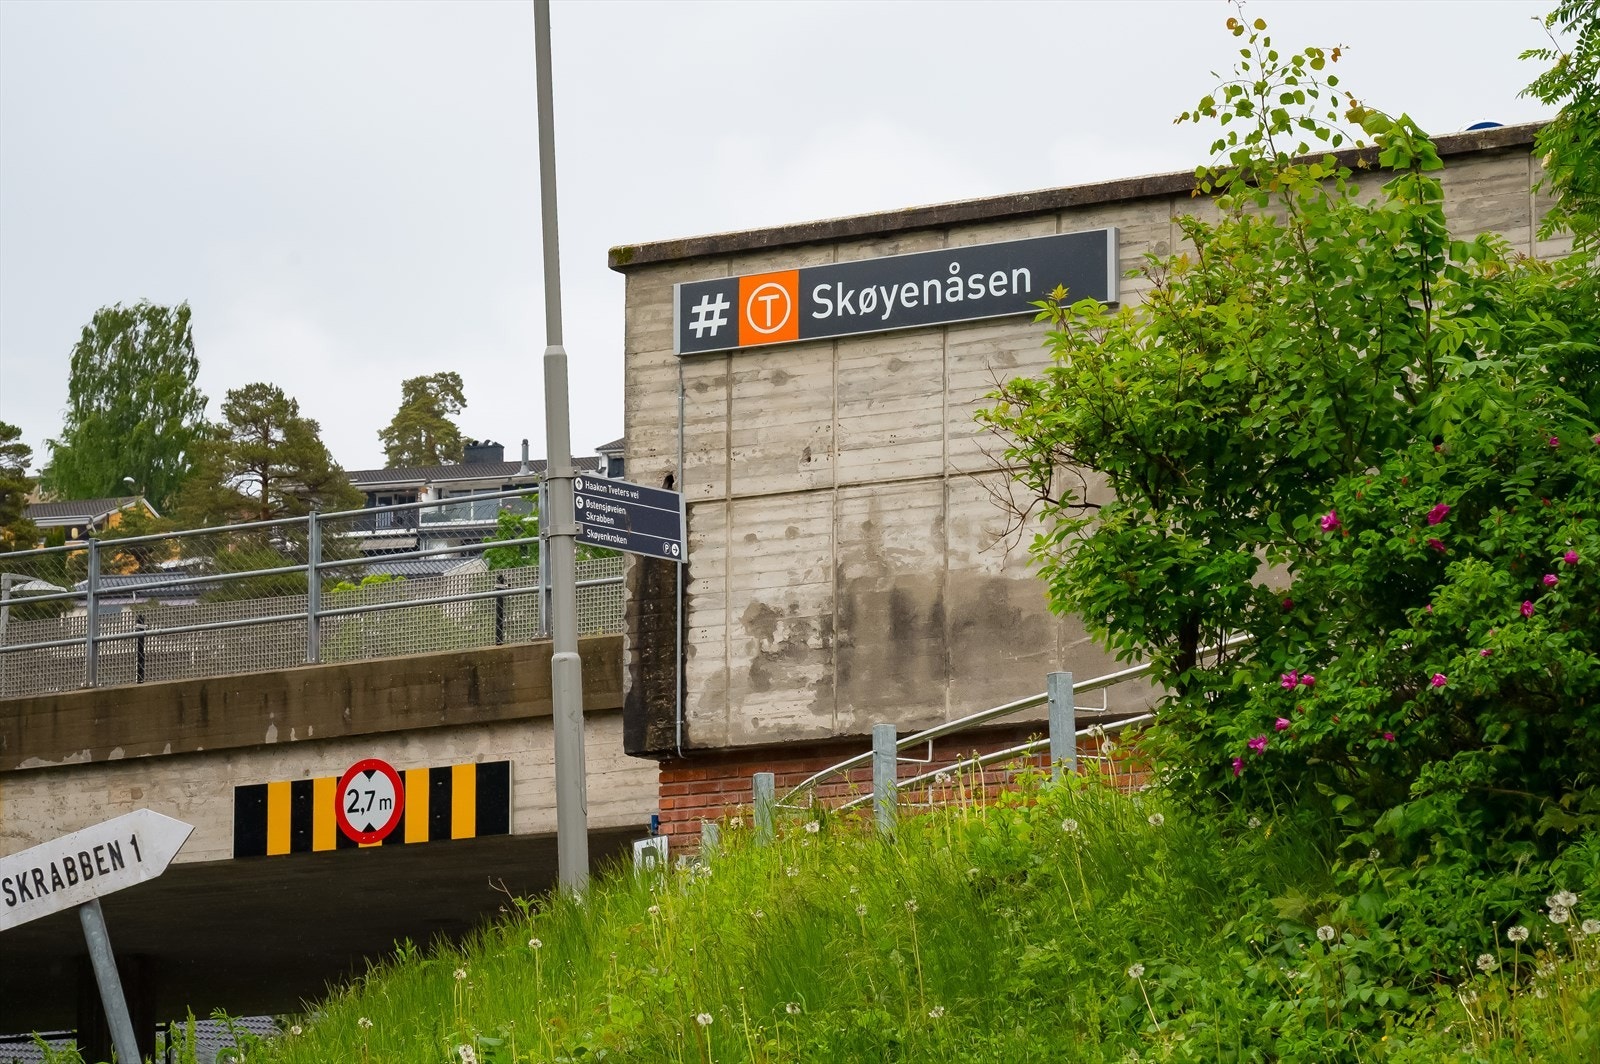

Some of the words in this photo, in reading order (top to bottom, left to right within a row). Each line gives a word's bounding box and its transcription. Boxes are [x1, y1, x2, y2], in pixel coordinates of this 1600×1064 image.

[758, 293, 780, 327] T
[811, 261, 1032, 321] Skøyenåsen
[585, 480, 608, 492] Haakon
[608, 485, 630, 498] Tveters
[630, 490, 639, 499] vei
[586, 499, 626, 515] Østensjøveien
[586, 511, 614, 524] Skrabben
[587, 529, 627, 544] Skøyenkroken
[347, 788, 375, 815] 2,7
[379, 798, 391, 810] m
[1, 839, 125, 907] SKRABBEN
[130, 834, 142, 862] 1
